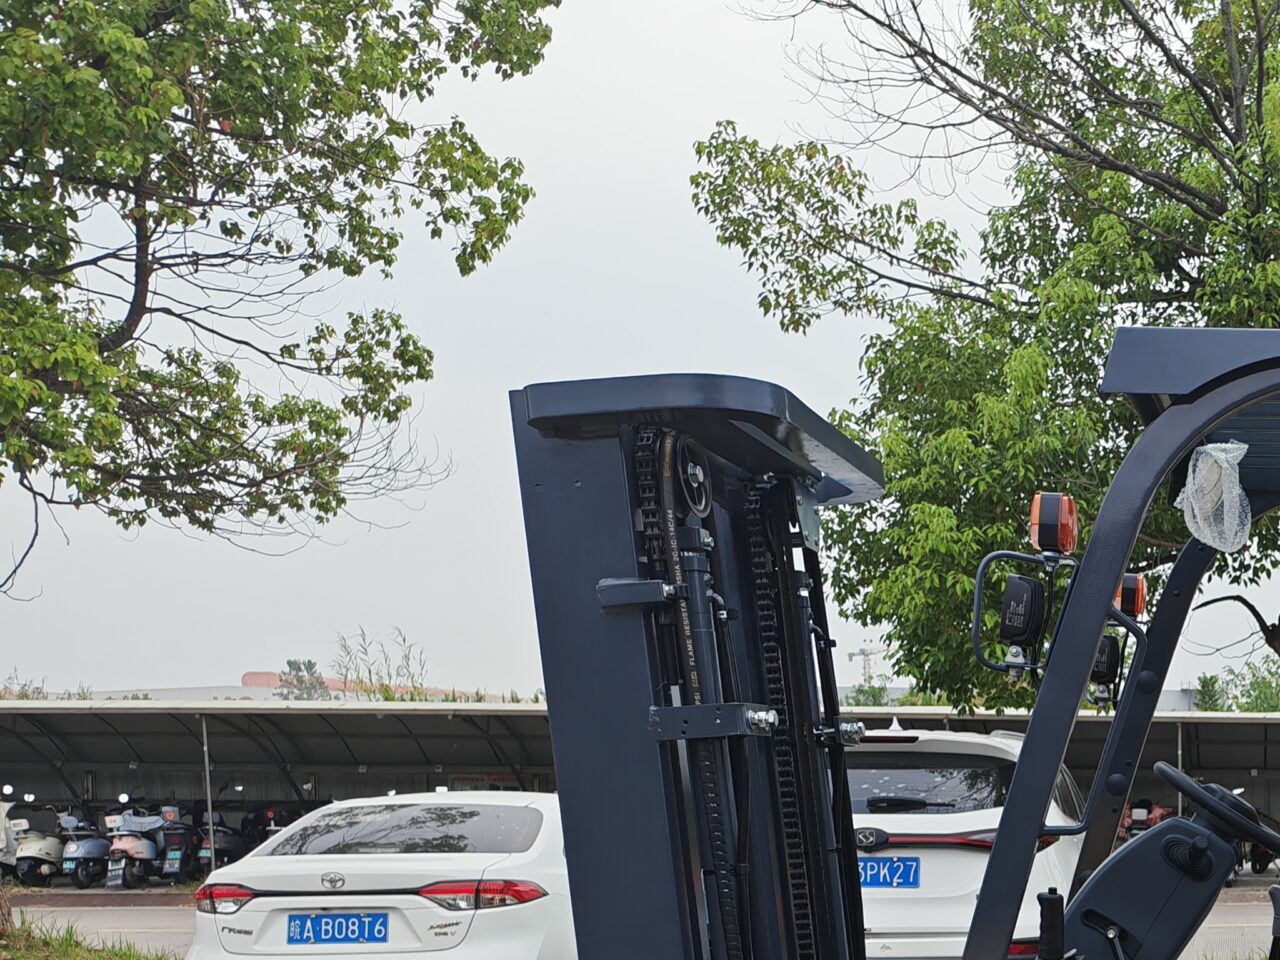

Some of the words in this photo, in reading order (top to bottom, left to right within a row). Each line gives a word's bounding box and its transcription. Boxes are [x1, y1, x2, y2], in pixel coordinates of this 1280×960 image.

[680, 599, 692, 636] RESISTA
[685, 638, 697, 667] FLAME
[858, 861, 917, 883] 3PK27
